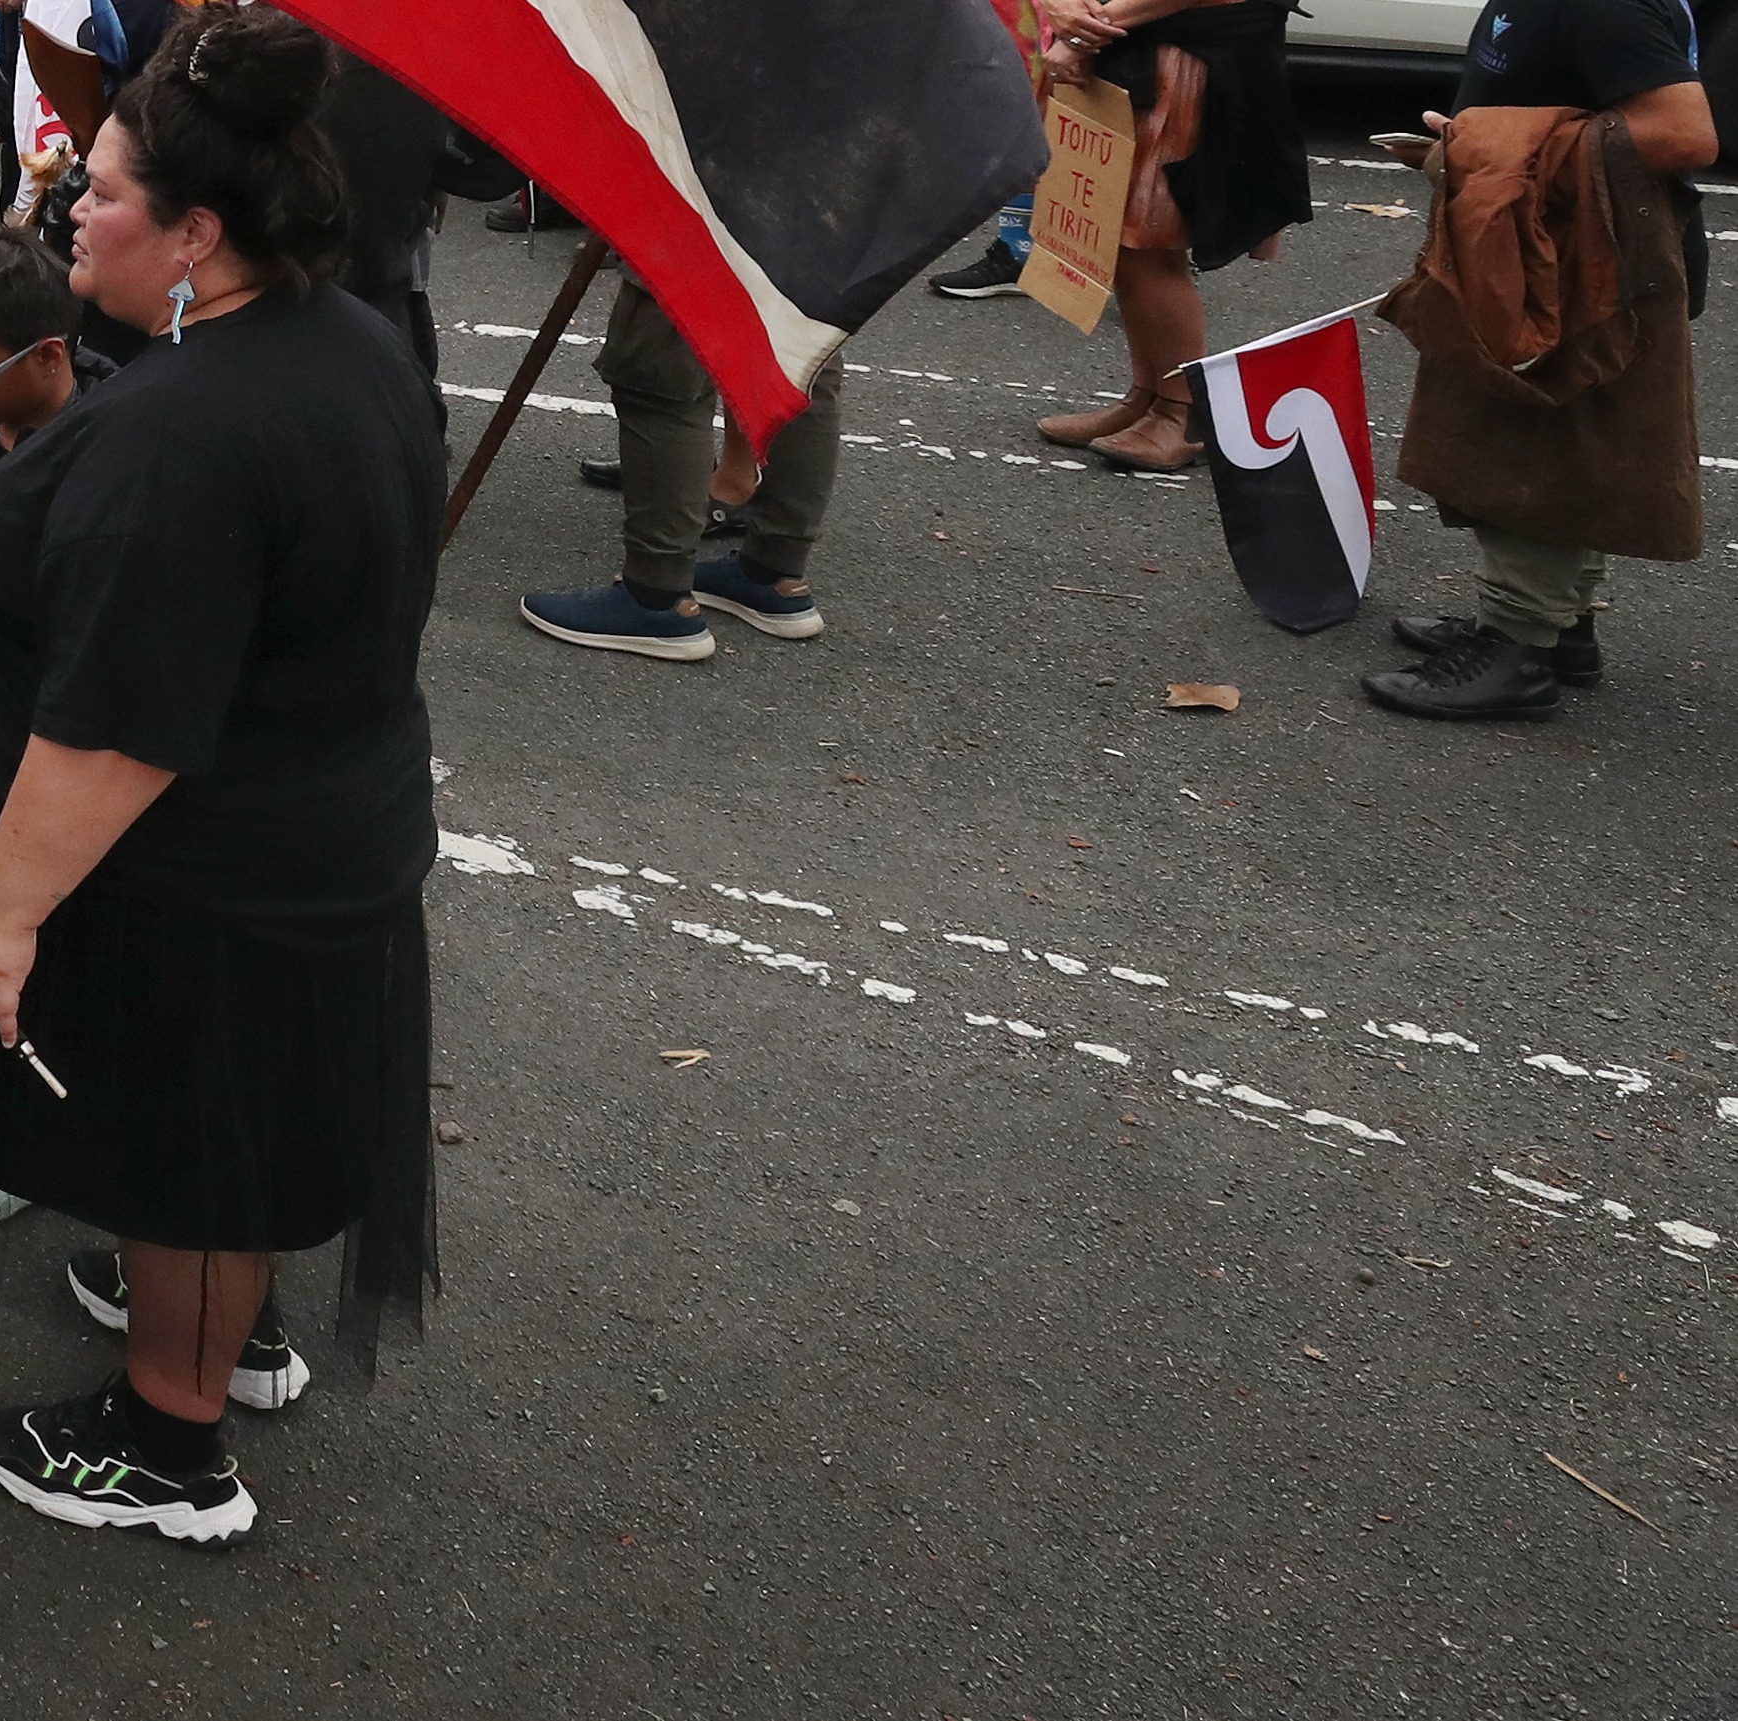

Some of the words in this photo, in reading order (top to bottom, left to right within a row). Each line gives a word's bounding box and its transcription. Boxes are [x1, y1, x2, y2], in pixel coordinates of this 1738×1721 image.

[1057, 114, 1114, 167] TOITŪ
[1071, 169, 1095, 209] TE
[1047, 198, 1100, 253] TIRITI
